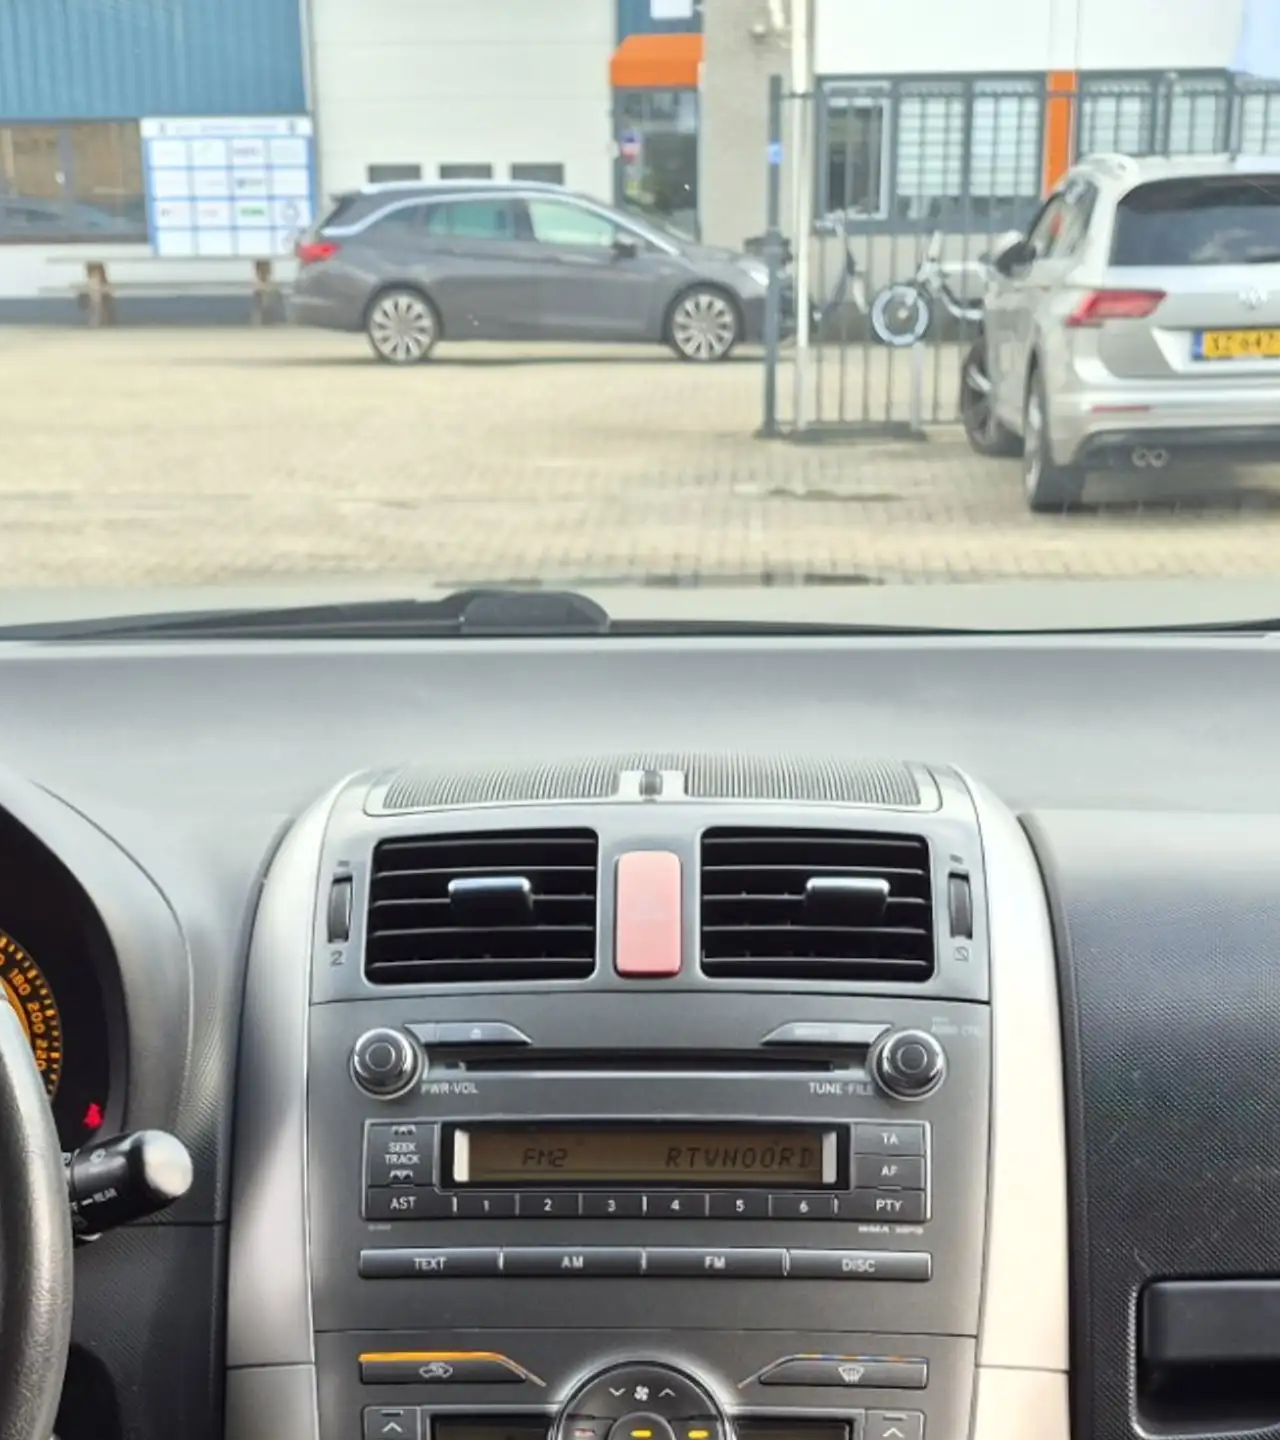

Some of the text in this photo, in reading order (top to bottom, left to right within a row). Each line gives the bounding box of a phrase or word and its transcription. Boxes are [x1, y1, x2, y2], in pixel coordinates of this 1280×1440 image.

[9, 968, 32, 997] 180
[27, 1001, 46, 1034] 200
[881, 1132, 899, 1146] TA
[388, 1141, 416, 1153] SEEK
[385, 1153, 420, 1166] TRACK
[523, 1148, 570, 1168] FM2
[881, 1165, 898, 1177] AF
[390, 1197, 417, 1211] AST
[484, 1200, 491, 1212] 1
[544, 1199, 553, 1212] 2
[607, 1199, 617, 1213] 3
[670, 1199, 680, 1212] 4
[736, 1199, 745, 1213] 5
[799, 1200, 809, 1213] 6
[875, 1199, 903, 1213] PTY
[413, 1257, 447, 1270] TEXT
[561, 1256, 584, 1269] AM
[704, 1256, 726, 1270] FM
[842, 1259, 876, 1273] DISC
